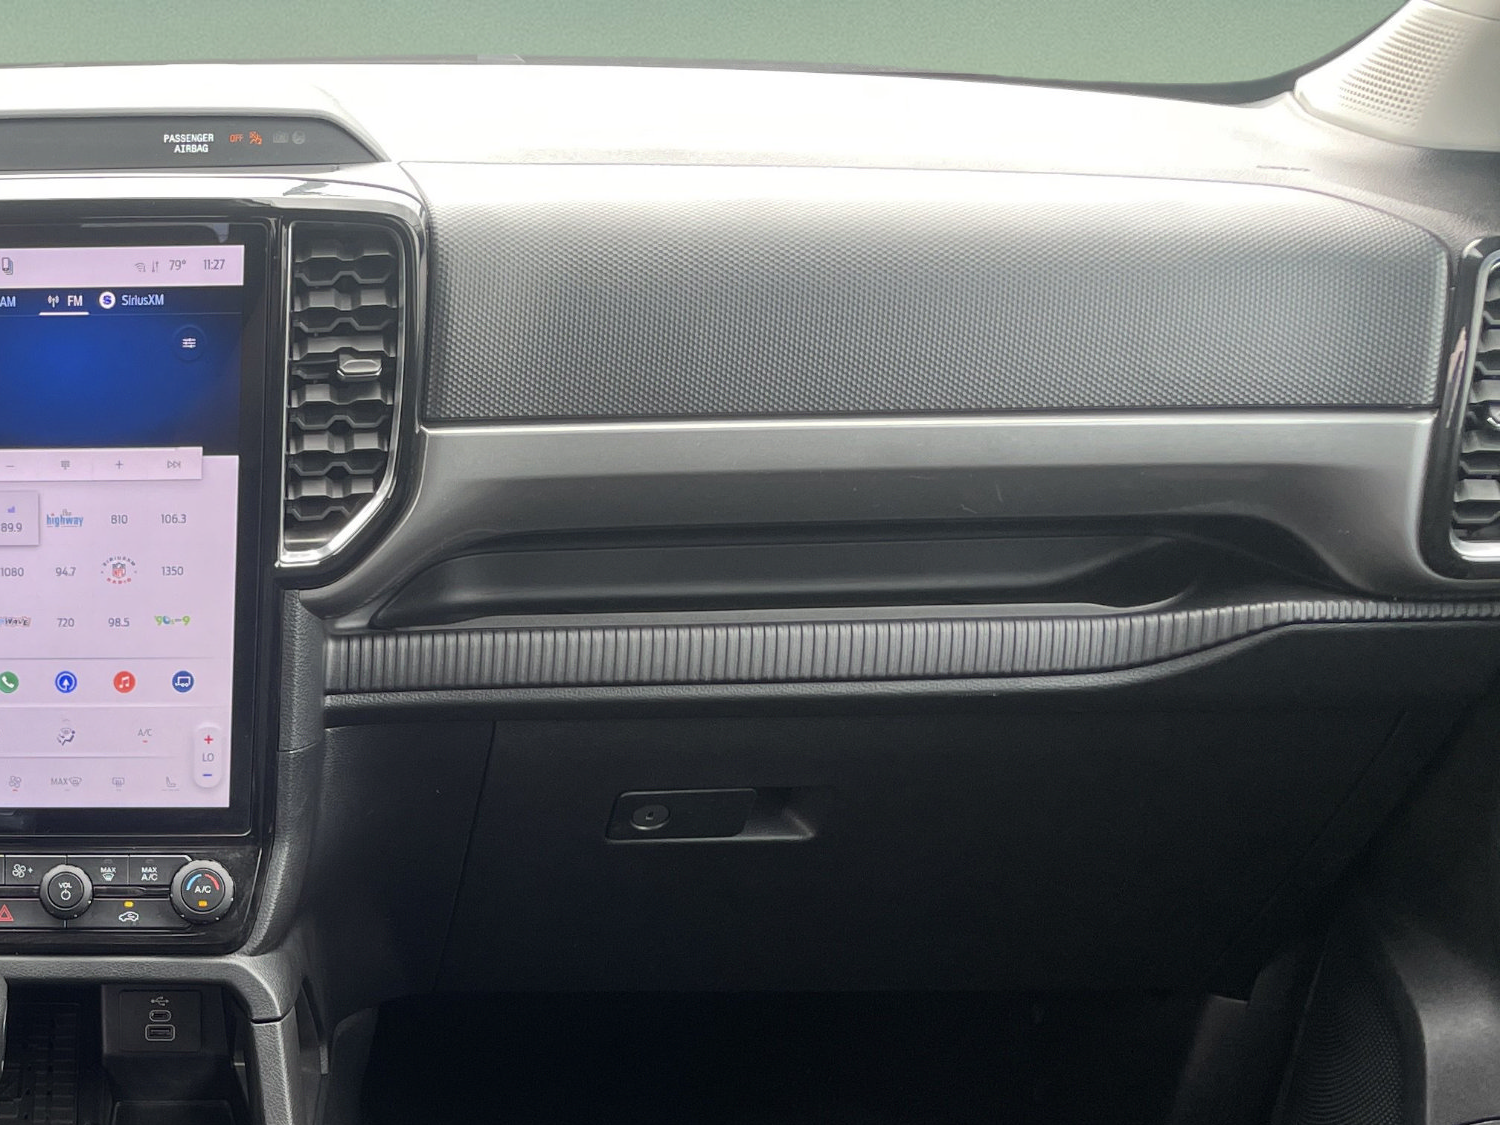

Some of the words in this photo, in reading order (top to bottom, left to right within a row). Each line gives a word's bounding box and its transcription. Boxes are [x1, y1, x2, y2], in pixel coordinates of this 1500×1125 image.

[163, 133, 214, 144] PASSENGER
[229, 133, 244, 143] OFF
[174, 144, 209, 153] AIRBAG
[203, 258, 226, 270] 11:27
[0, 296, 16, 307] AM
[67, 295, 83, 306] FM
[121, 293, 165, 306] SiriusXM
[46, 513, 84, 527] highway
[110, 514, 128, 525] 810
[161, 513, 187, 524] 106.3
[0, 522, 22, 533] 89.9
[0, 567, 24, 577] 1080
[55, 566, 76, 577] 94.7
[161, 566, 184, 576] 1350
[57, 617, 75, 628] 720
[108, 617, 130, 627] 98.5
[202, 752, 215, 762] LO
[51, 777, 68, 786] MAX
[194, 886, 211, 894] A/C
